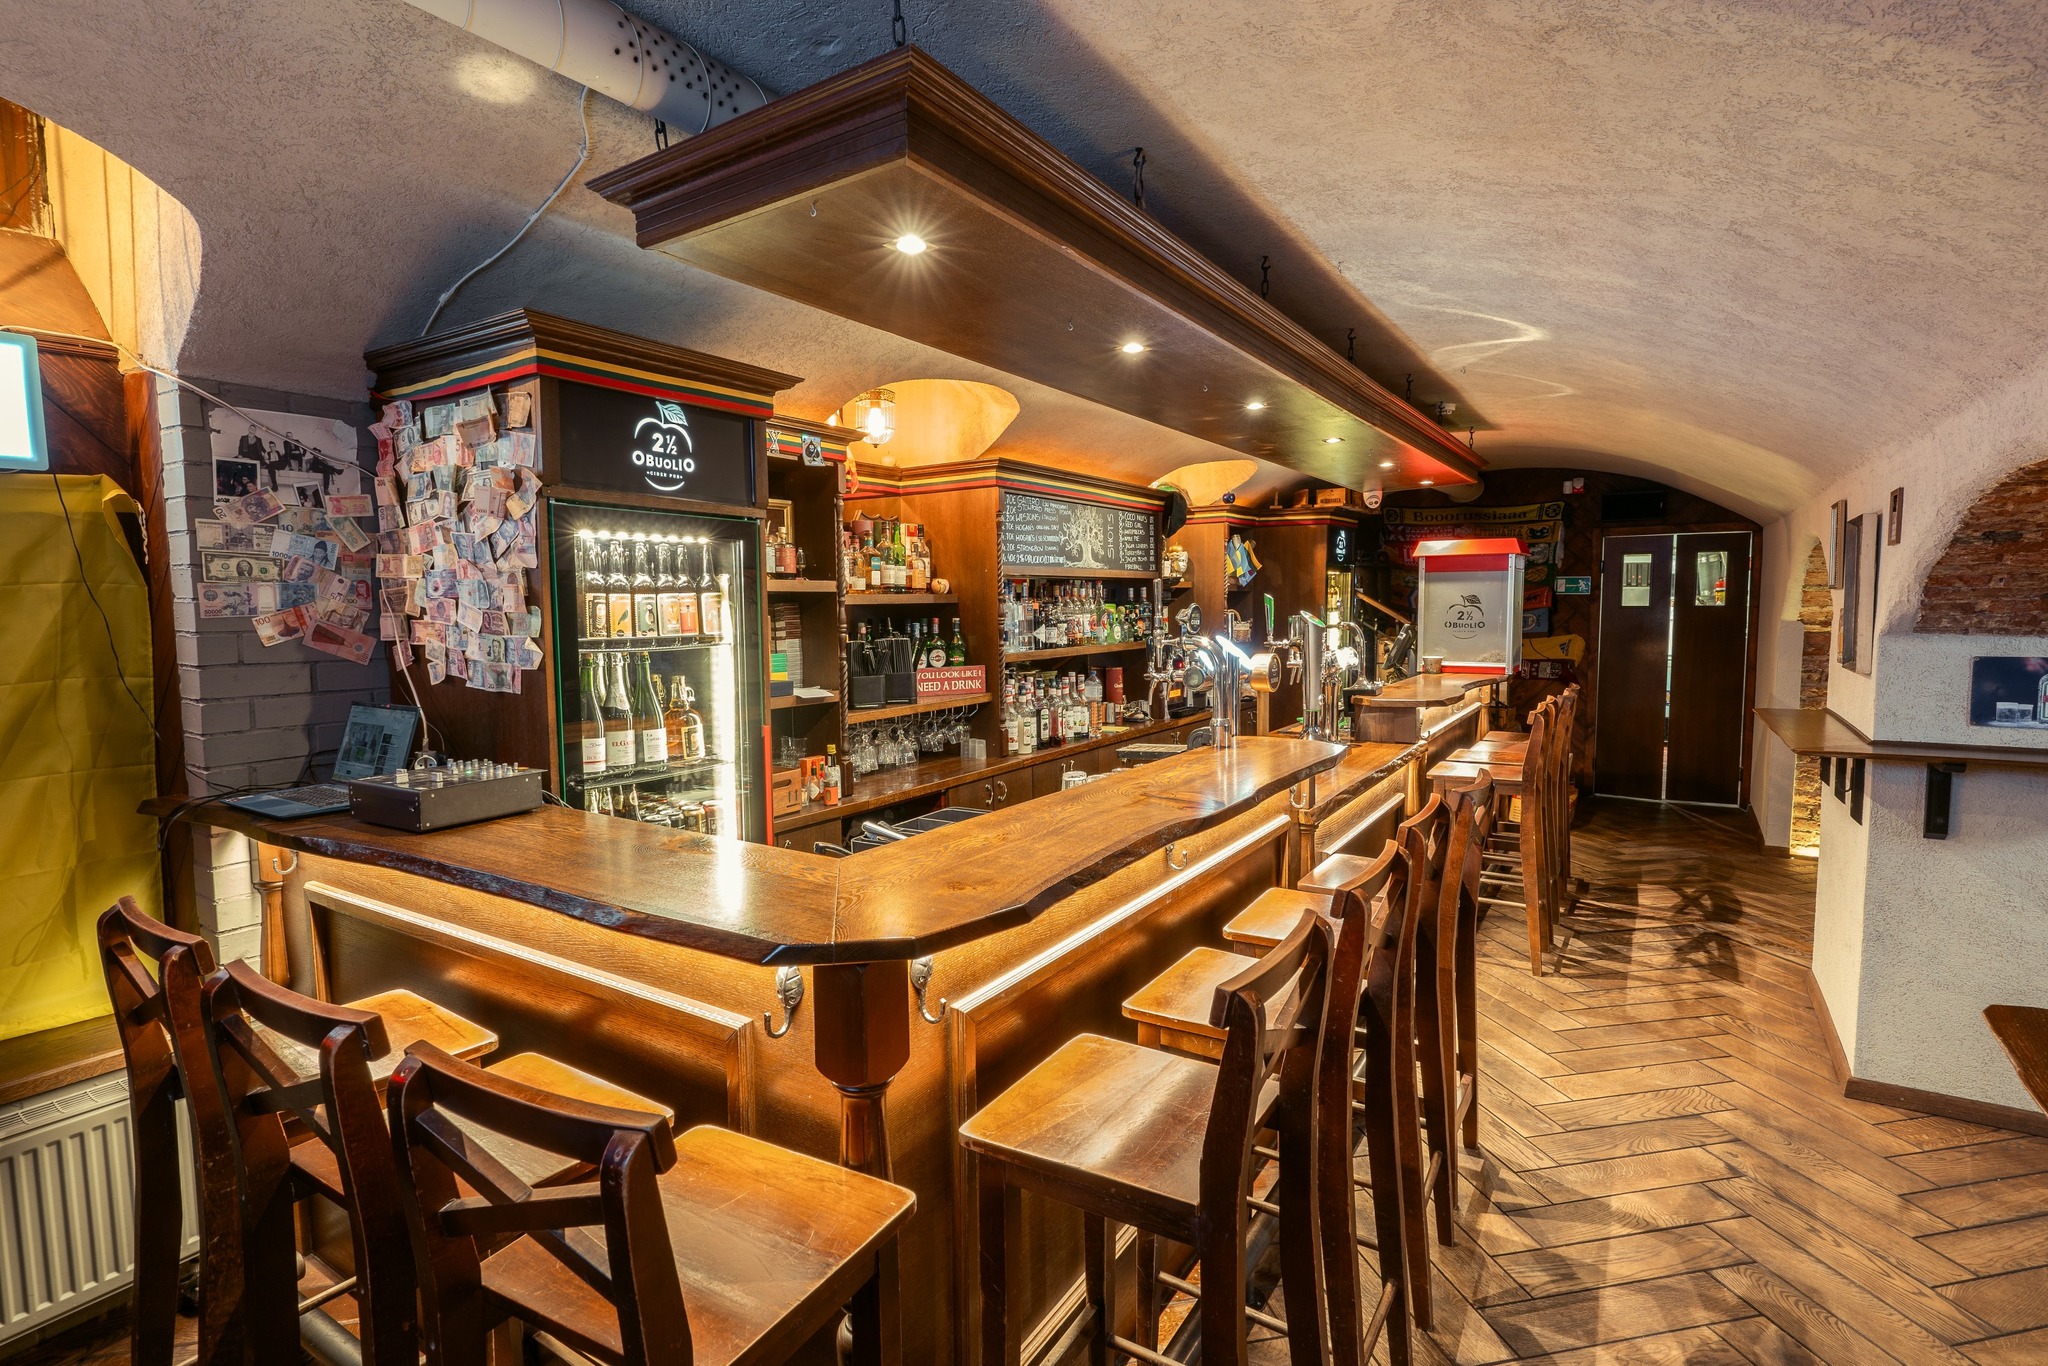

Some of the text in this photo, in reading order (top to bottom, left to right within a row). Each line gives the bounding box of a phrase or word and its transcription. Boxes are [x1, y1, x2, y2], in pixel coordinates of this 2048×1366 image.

[632, 450, 695, 472] OBUOLIO
[1413, 510, 1527, 522] Booorussiaaa
[281, 524, 294, 532] 10
[255, 616, 270, 626] 100
[1444, 621, 1485, 629] OBUOLIO
[918, 680, 982, 692] NEED A DRINK
